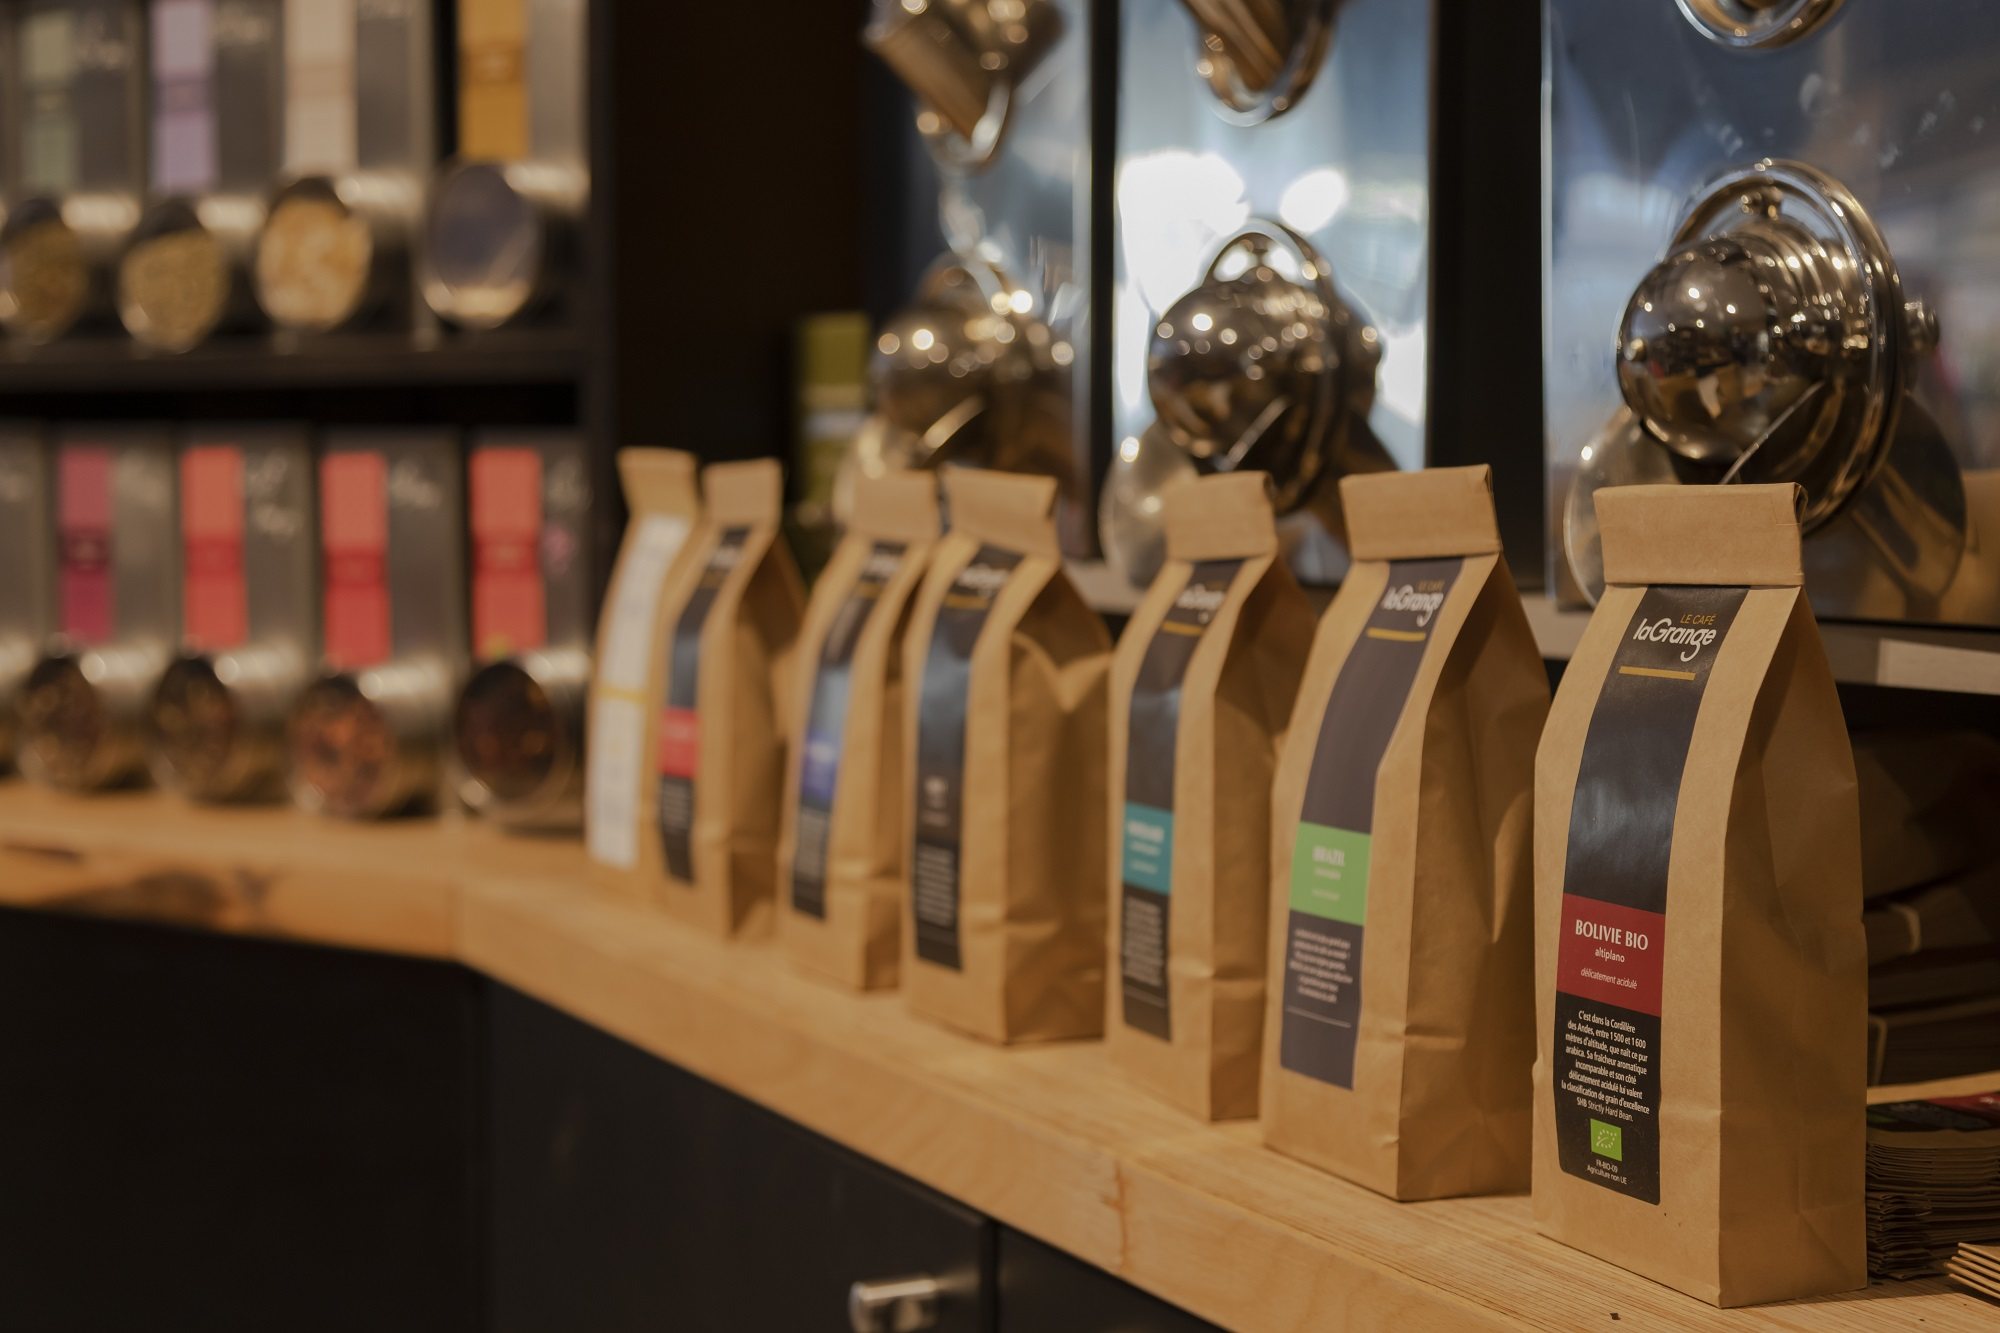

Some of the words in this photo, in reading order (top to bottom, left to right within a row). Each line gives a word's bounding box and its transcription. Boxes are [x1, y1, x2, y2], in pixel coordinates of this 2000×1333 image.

[1680, 614, 1690, 624] LE
[1692, 613, 1716, 625] CAFÉ
[1633, 618, 1716, 662] laGrange
[1576, 919, 1621, 945] BOLIVIE
[1625, 931, 1648, 950] BIO
[1595, 947, 1625, 962] altiplano
[1581, 968, 1616, 984] délicatement
[1617, 978, 1638, 989] acidulé
[1568, 1020, 1576, 1030] des
[1578, 1023, 1594, 1036] Andes,
[1596, 1029, 1609, 1039] entre
[1625, 1037, 1630, 1045] et
[1579, 1011, 1591, 1021] C'est
[1592, 1014, 1604, 1026] dans
[1605, 1017, 1610, 1027] la
[1611, 1019, 1635, 1034] Cordillère
[1566, 1033, 1582, 1045] mètres
[1610, 1046, 1619, 1056] que
[1639, 1054, 1648, 1062] pur
[1576, 1059, 1608, 1077] incomparable
[1615, 1072, 1624, 1081] son
[1587, 1050, 1593, 1060] Sa
[1617, 1060, 1647, 1076] aromatique
[1561, 1080, 1566, 1089] la
[1567, 1082, 1597, 1098] classification
[1598, 1091, 1604, 1100] de
[1605, 1094, 1618, 1105] grain
[1569, 1070, 1600, 1086] délicatement
[1601, 1078, 1618, 1092] acidulé
[1627, 1088, 1643, 1100] valent
[1588, 1100, 1604, 1114] Strictly
[1606, 1107, 1618, 1118] Hard
[1587, 1165, 1610, 1179] Agriculture
